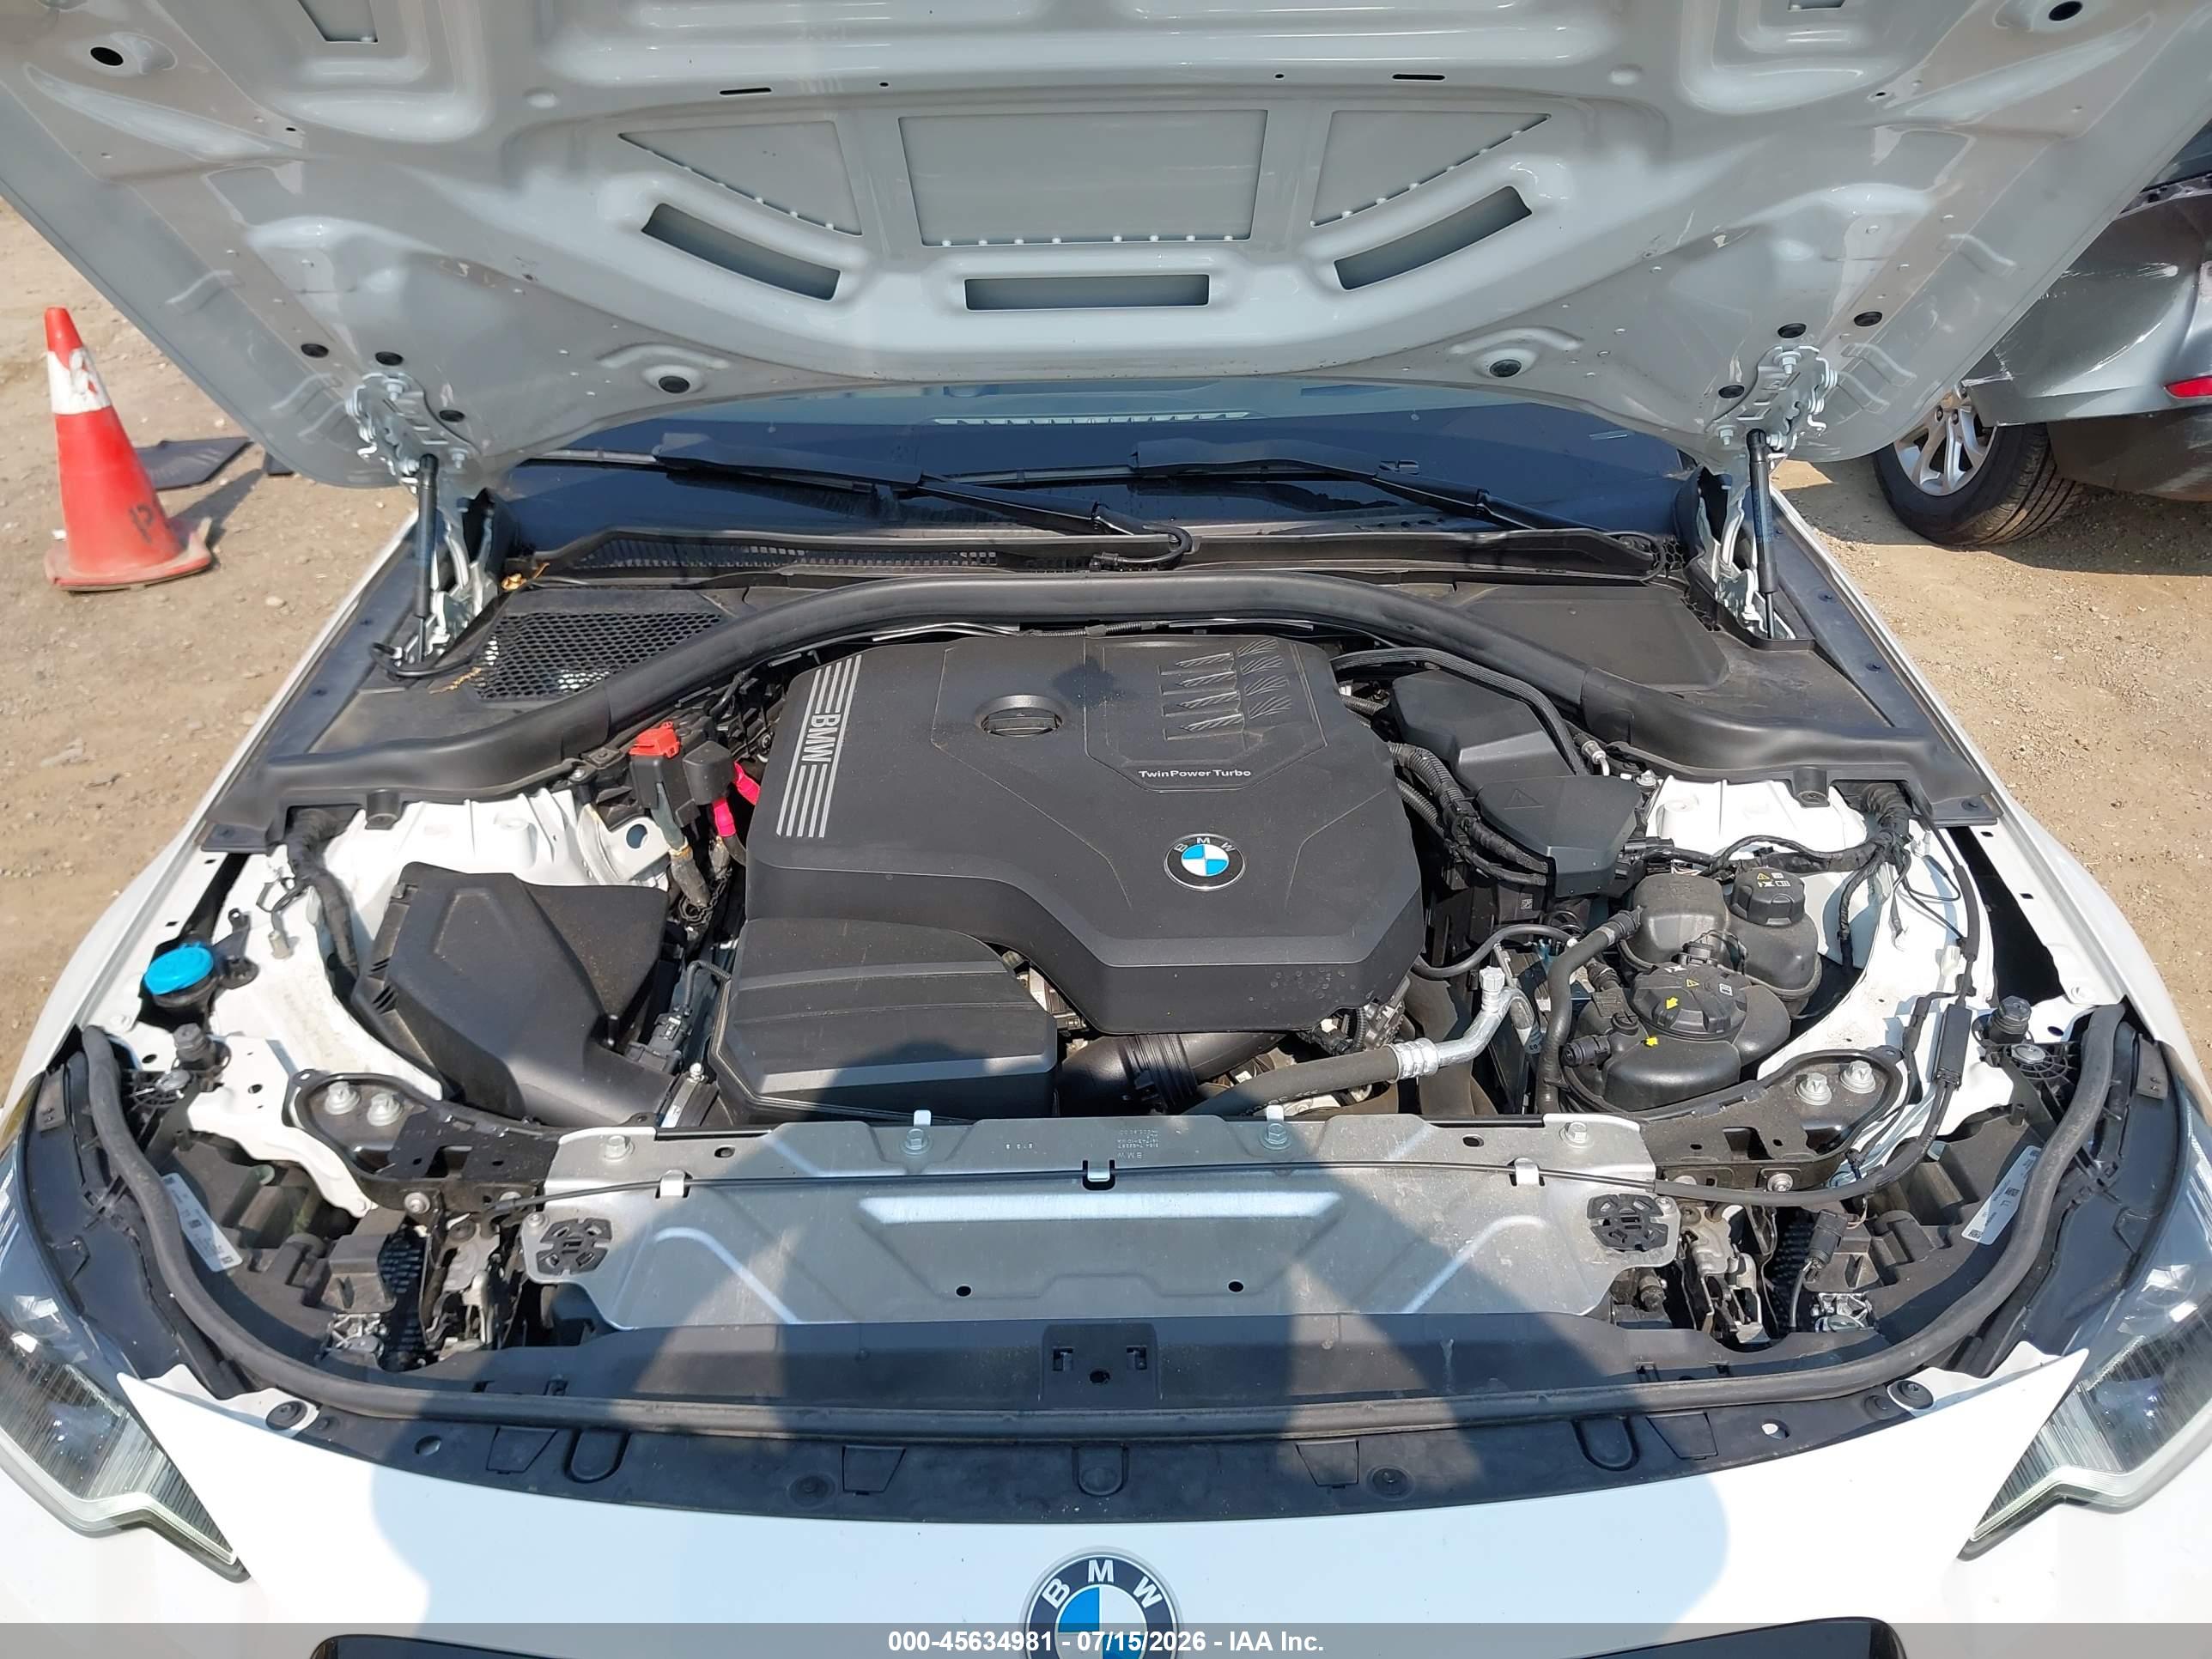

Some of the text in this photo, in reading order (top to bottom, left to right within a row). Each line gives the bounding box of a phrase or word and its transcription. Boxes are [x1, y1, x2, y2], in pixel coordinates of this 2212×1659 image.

[801, 714, 842, 763] BMW
[1212, 769, 1252, 777] Turbo
[1174, 836, 1236, 853] BMW
[1042, 1559, 1164, 1610] BMW
